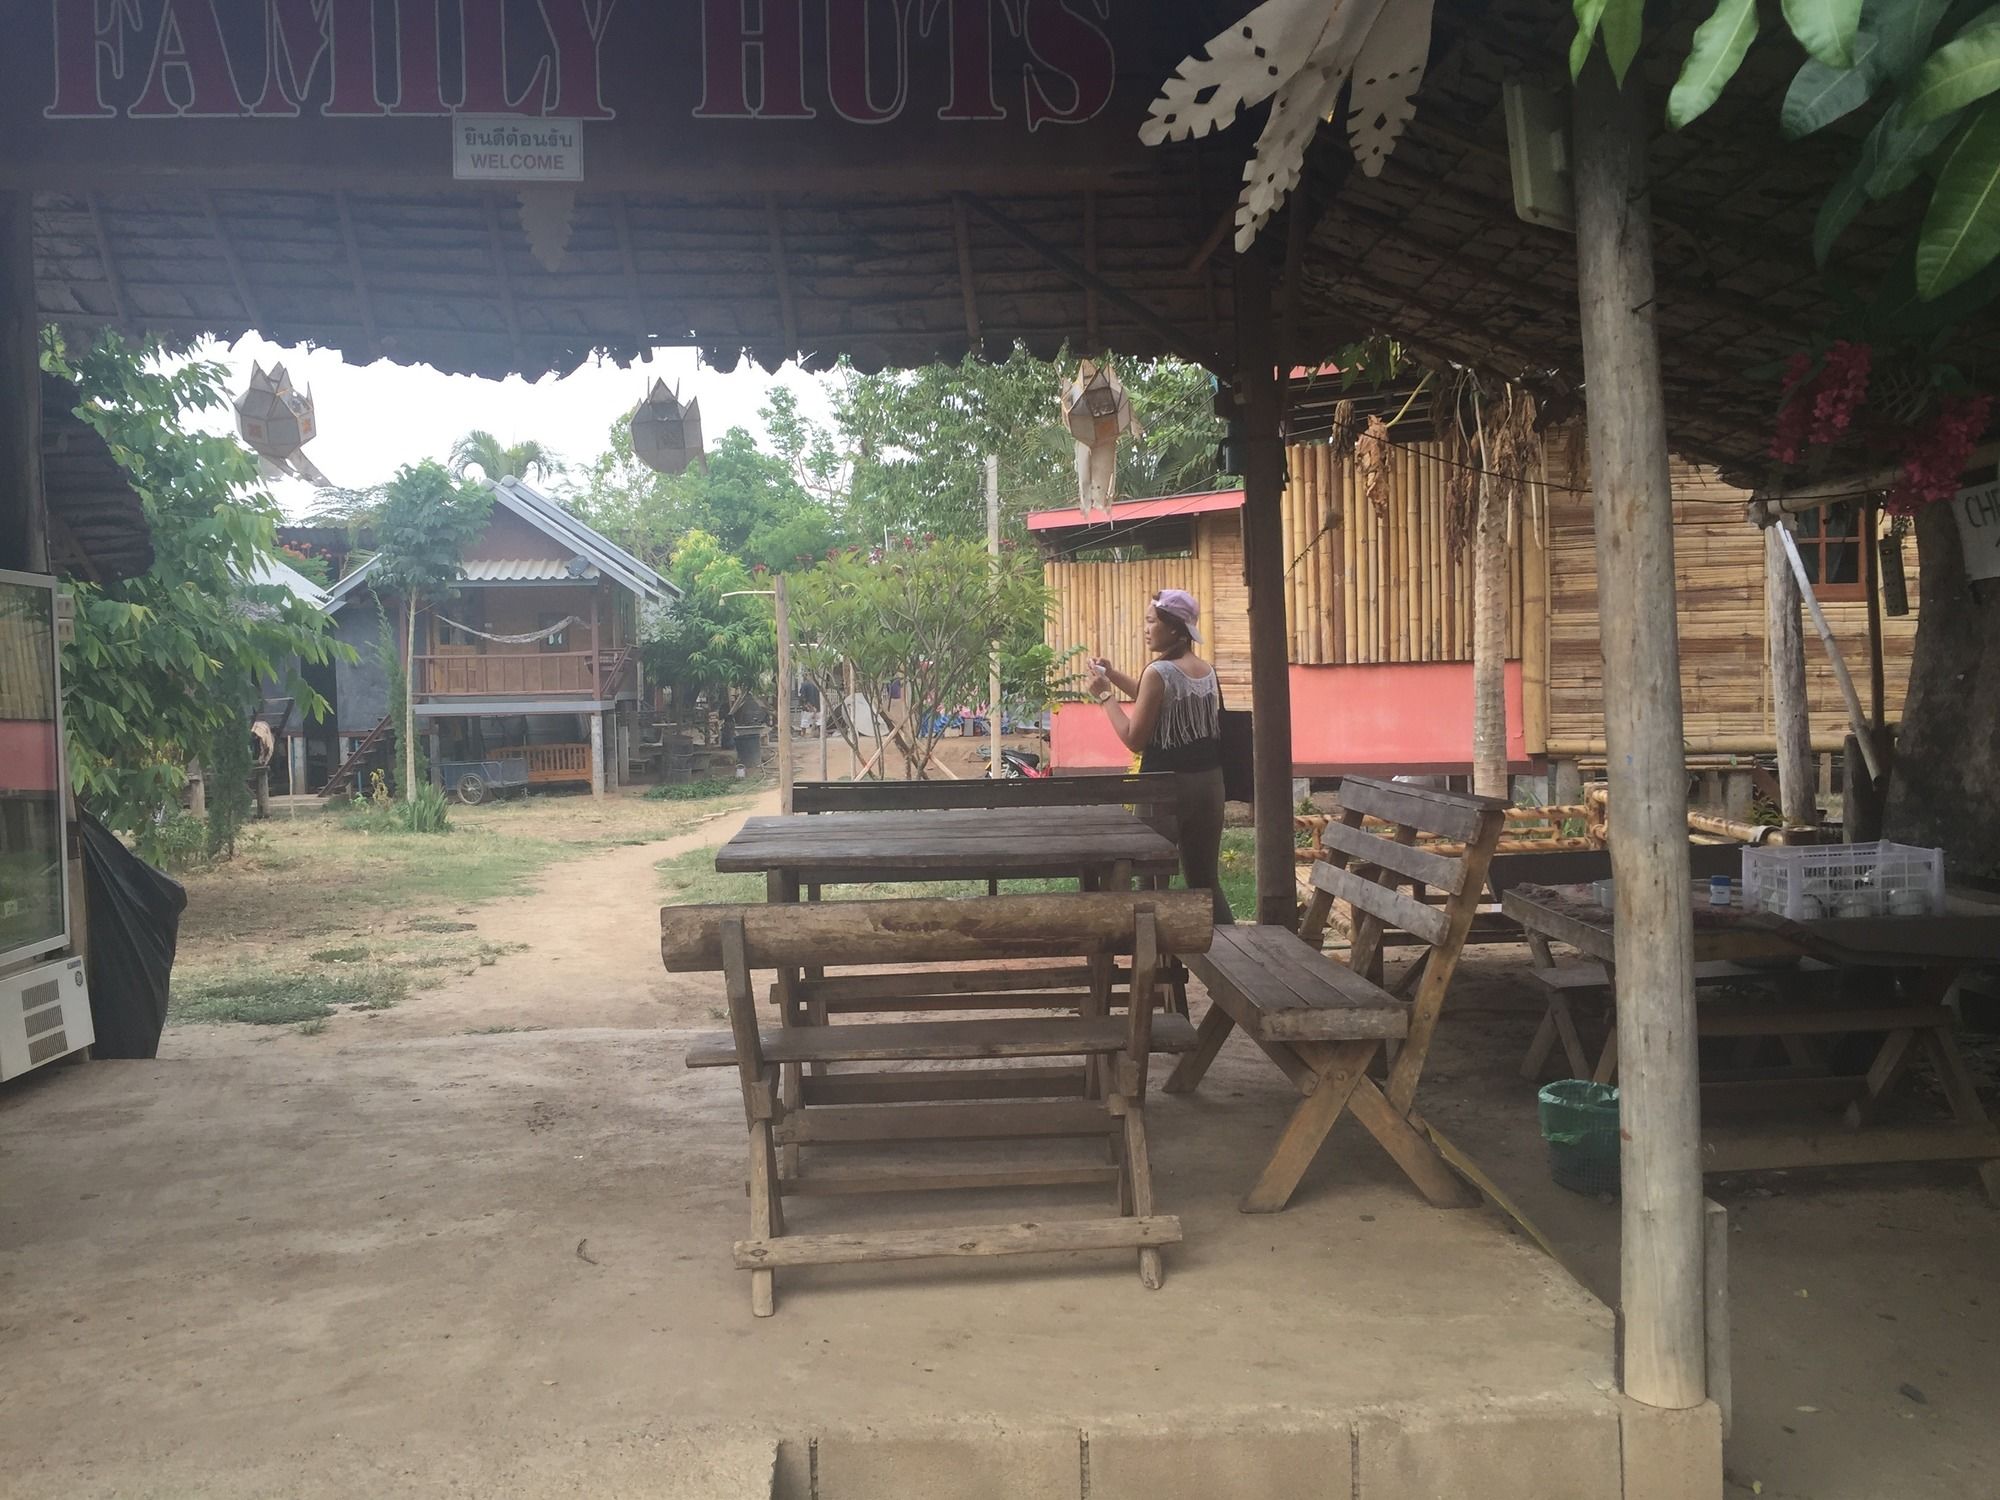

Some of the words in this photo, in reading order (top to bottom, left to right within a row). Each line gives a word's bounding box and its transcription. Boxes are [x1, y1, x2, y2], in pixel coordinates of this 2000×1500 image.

[43, 0, 616, 119] FAMILY
[692, 0, 1116, 133] HUTS
[464, 127, 573, 147] ยินดีต้อนรับ
[470, 153, 565, 170] WELCOME
